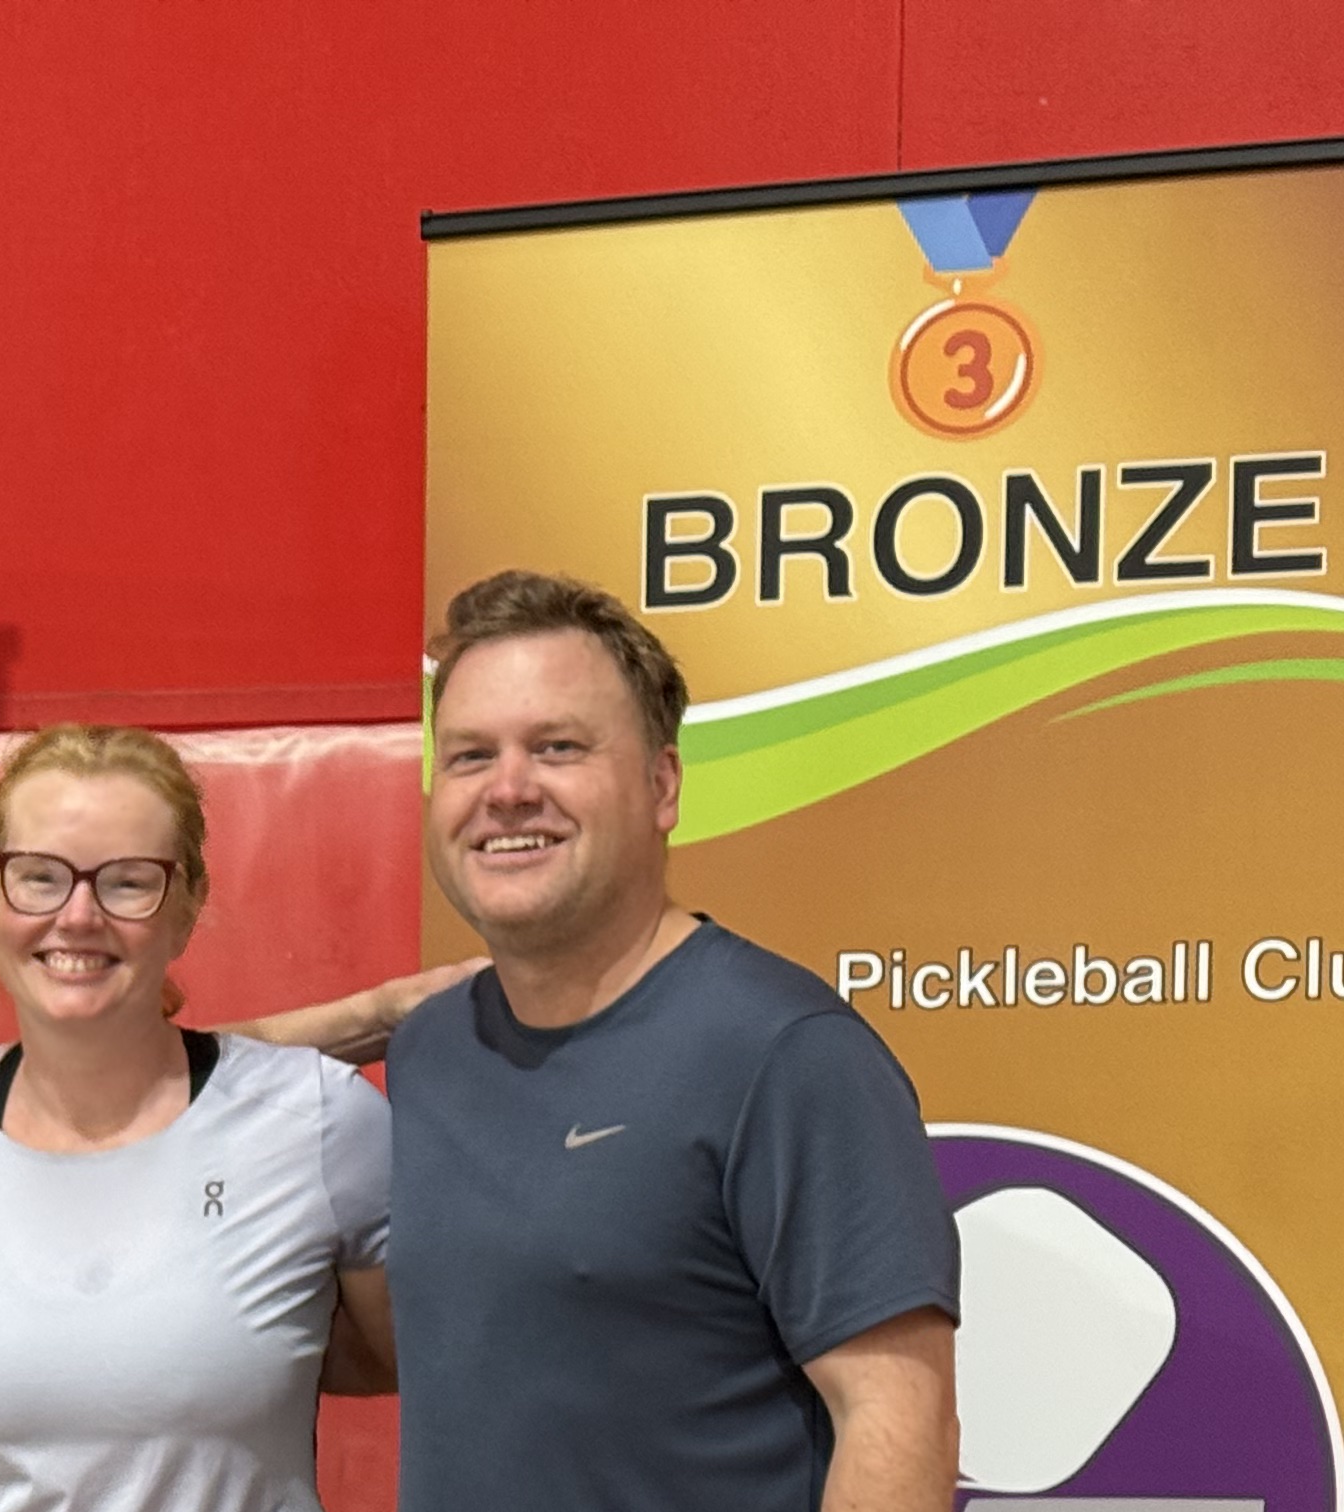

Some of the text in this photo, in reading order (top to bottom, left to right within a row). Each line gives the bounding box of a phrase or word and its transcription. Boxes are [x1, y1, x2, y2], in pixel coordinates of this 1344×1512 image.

[943, 328, 994, 411] 3
[644, 453, 1326, 609] BRONZE
[835, 938, 1214, 1011] Pickleball
